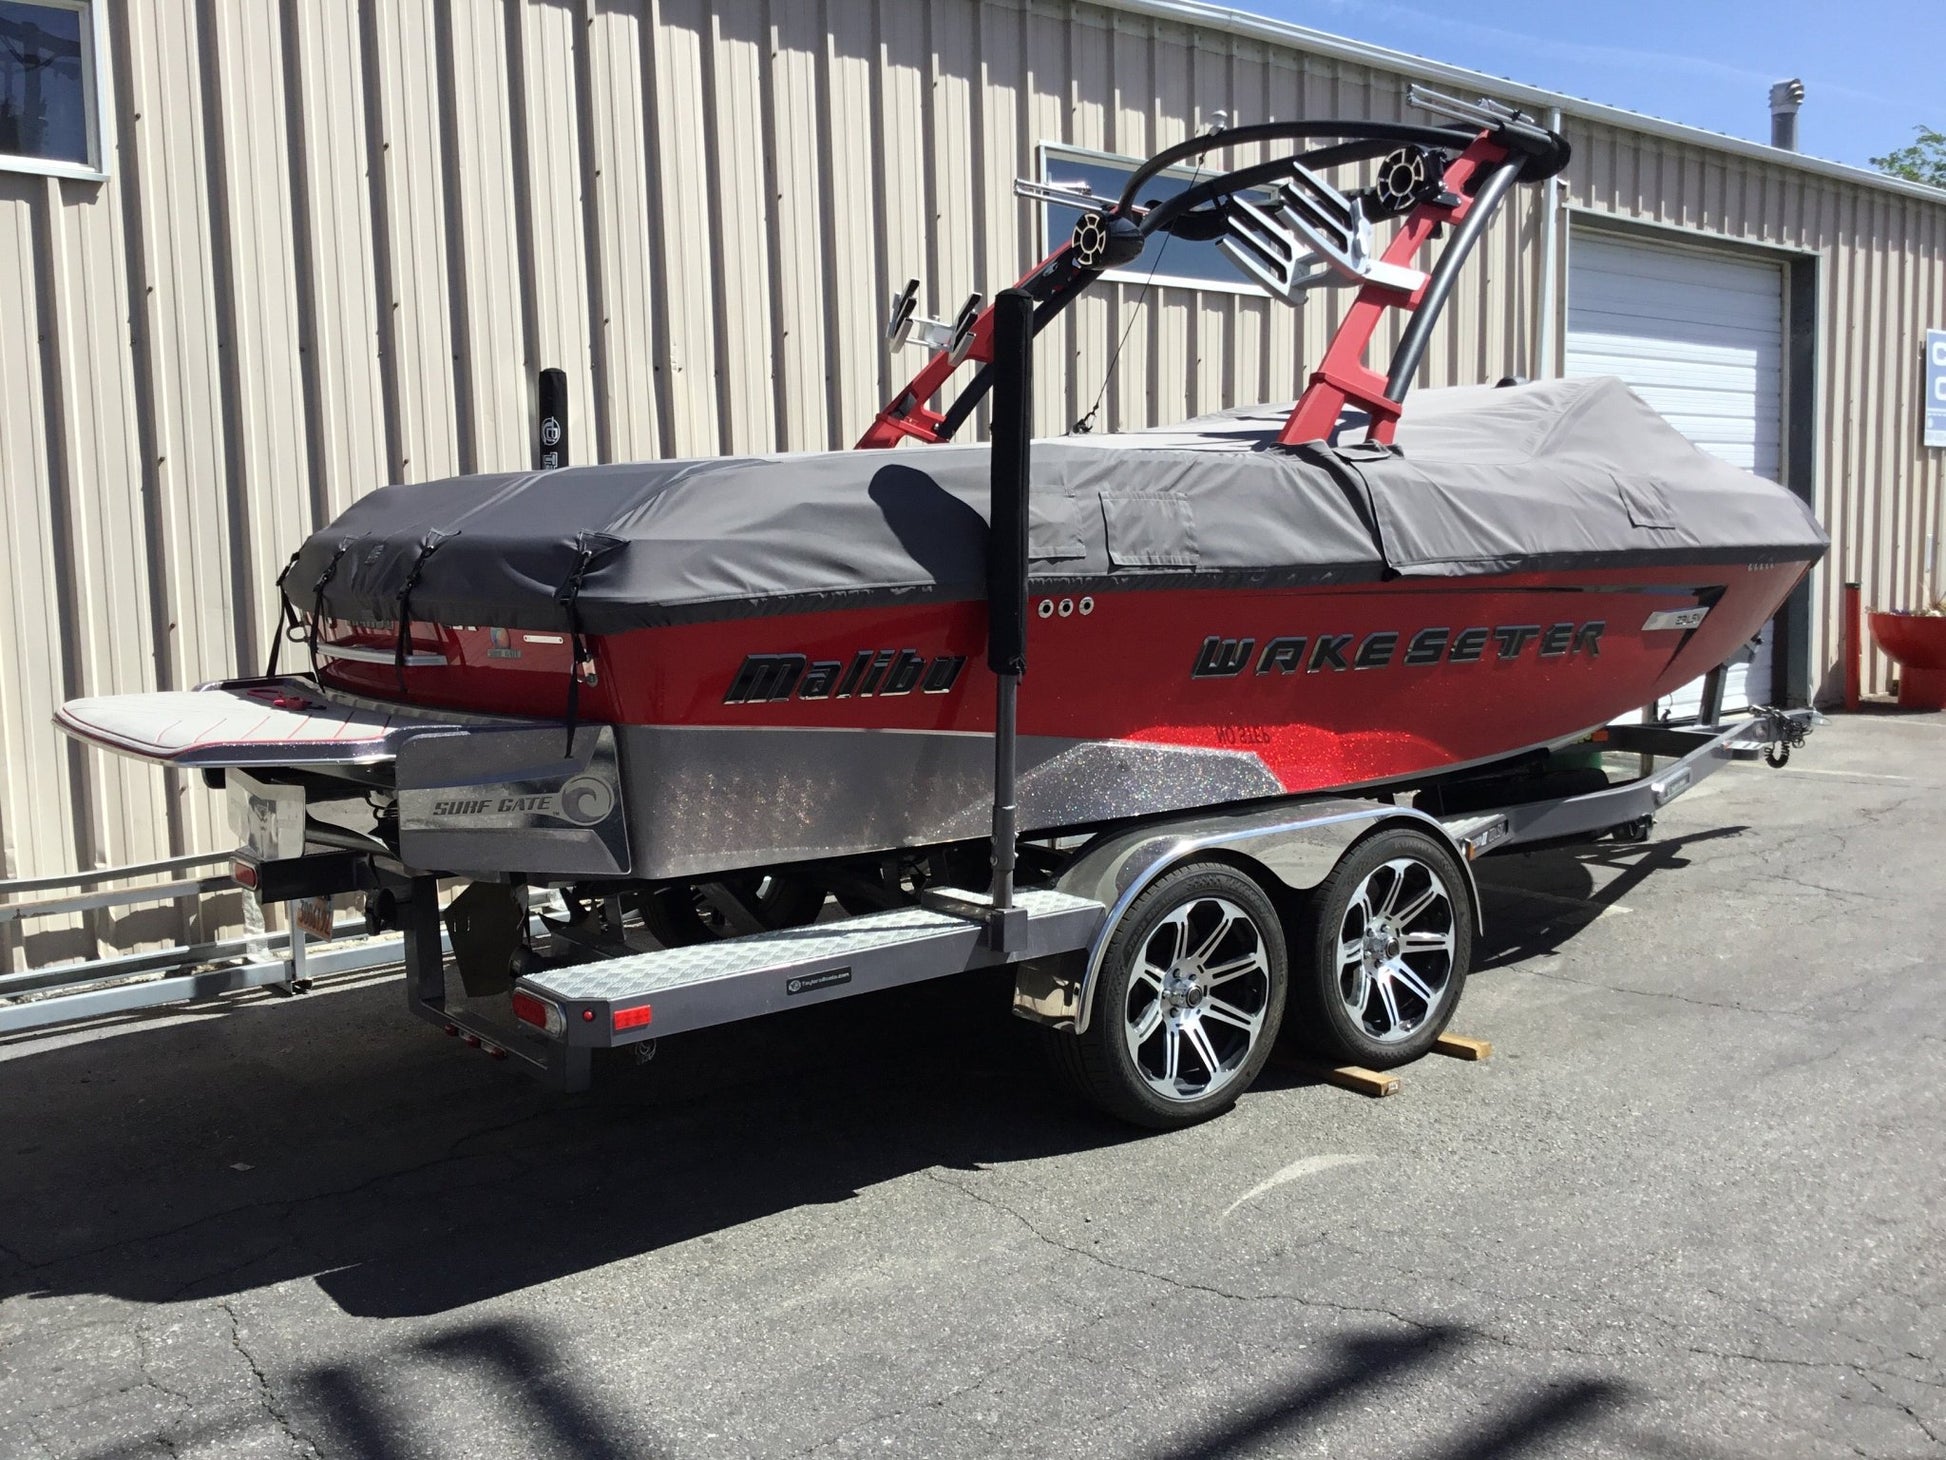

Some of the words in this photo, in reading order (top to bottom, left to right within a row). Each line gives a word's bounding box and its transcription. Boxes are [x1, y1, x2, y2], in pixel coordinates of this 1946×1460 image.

[723, 649, 968, 704] Malibu
[433, 799, 493, 815] SURF
[498, 796, 553, 812] GATE
